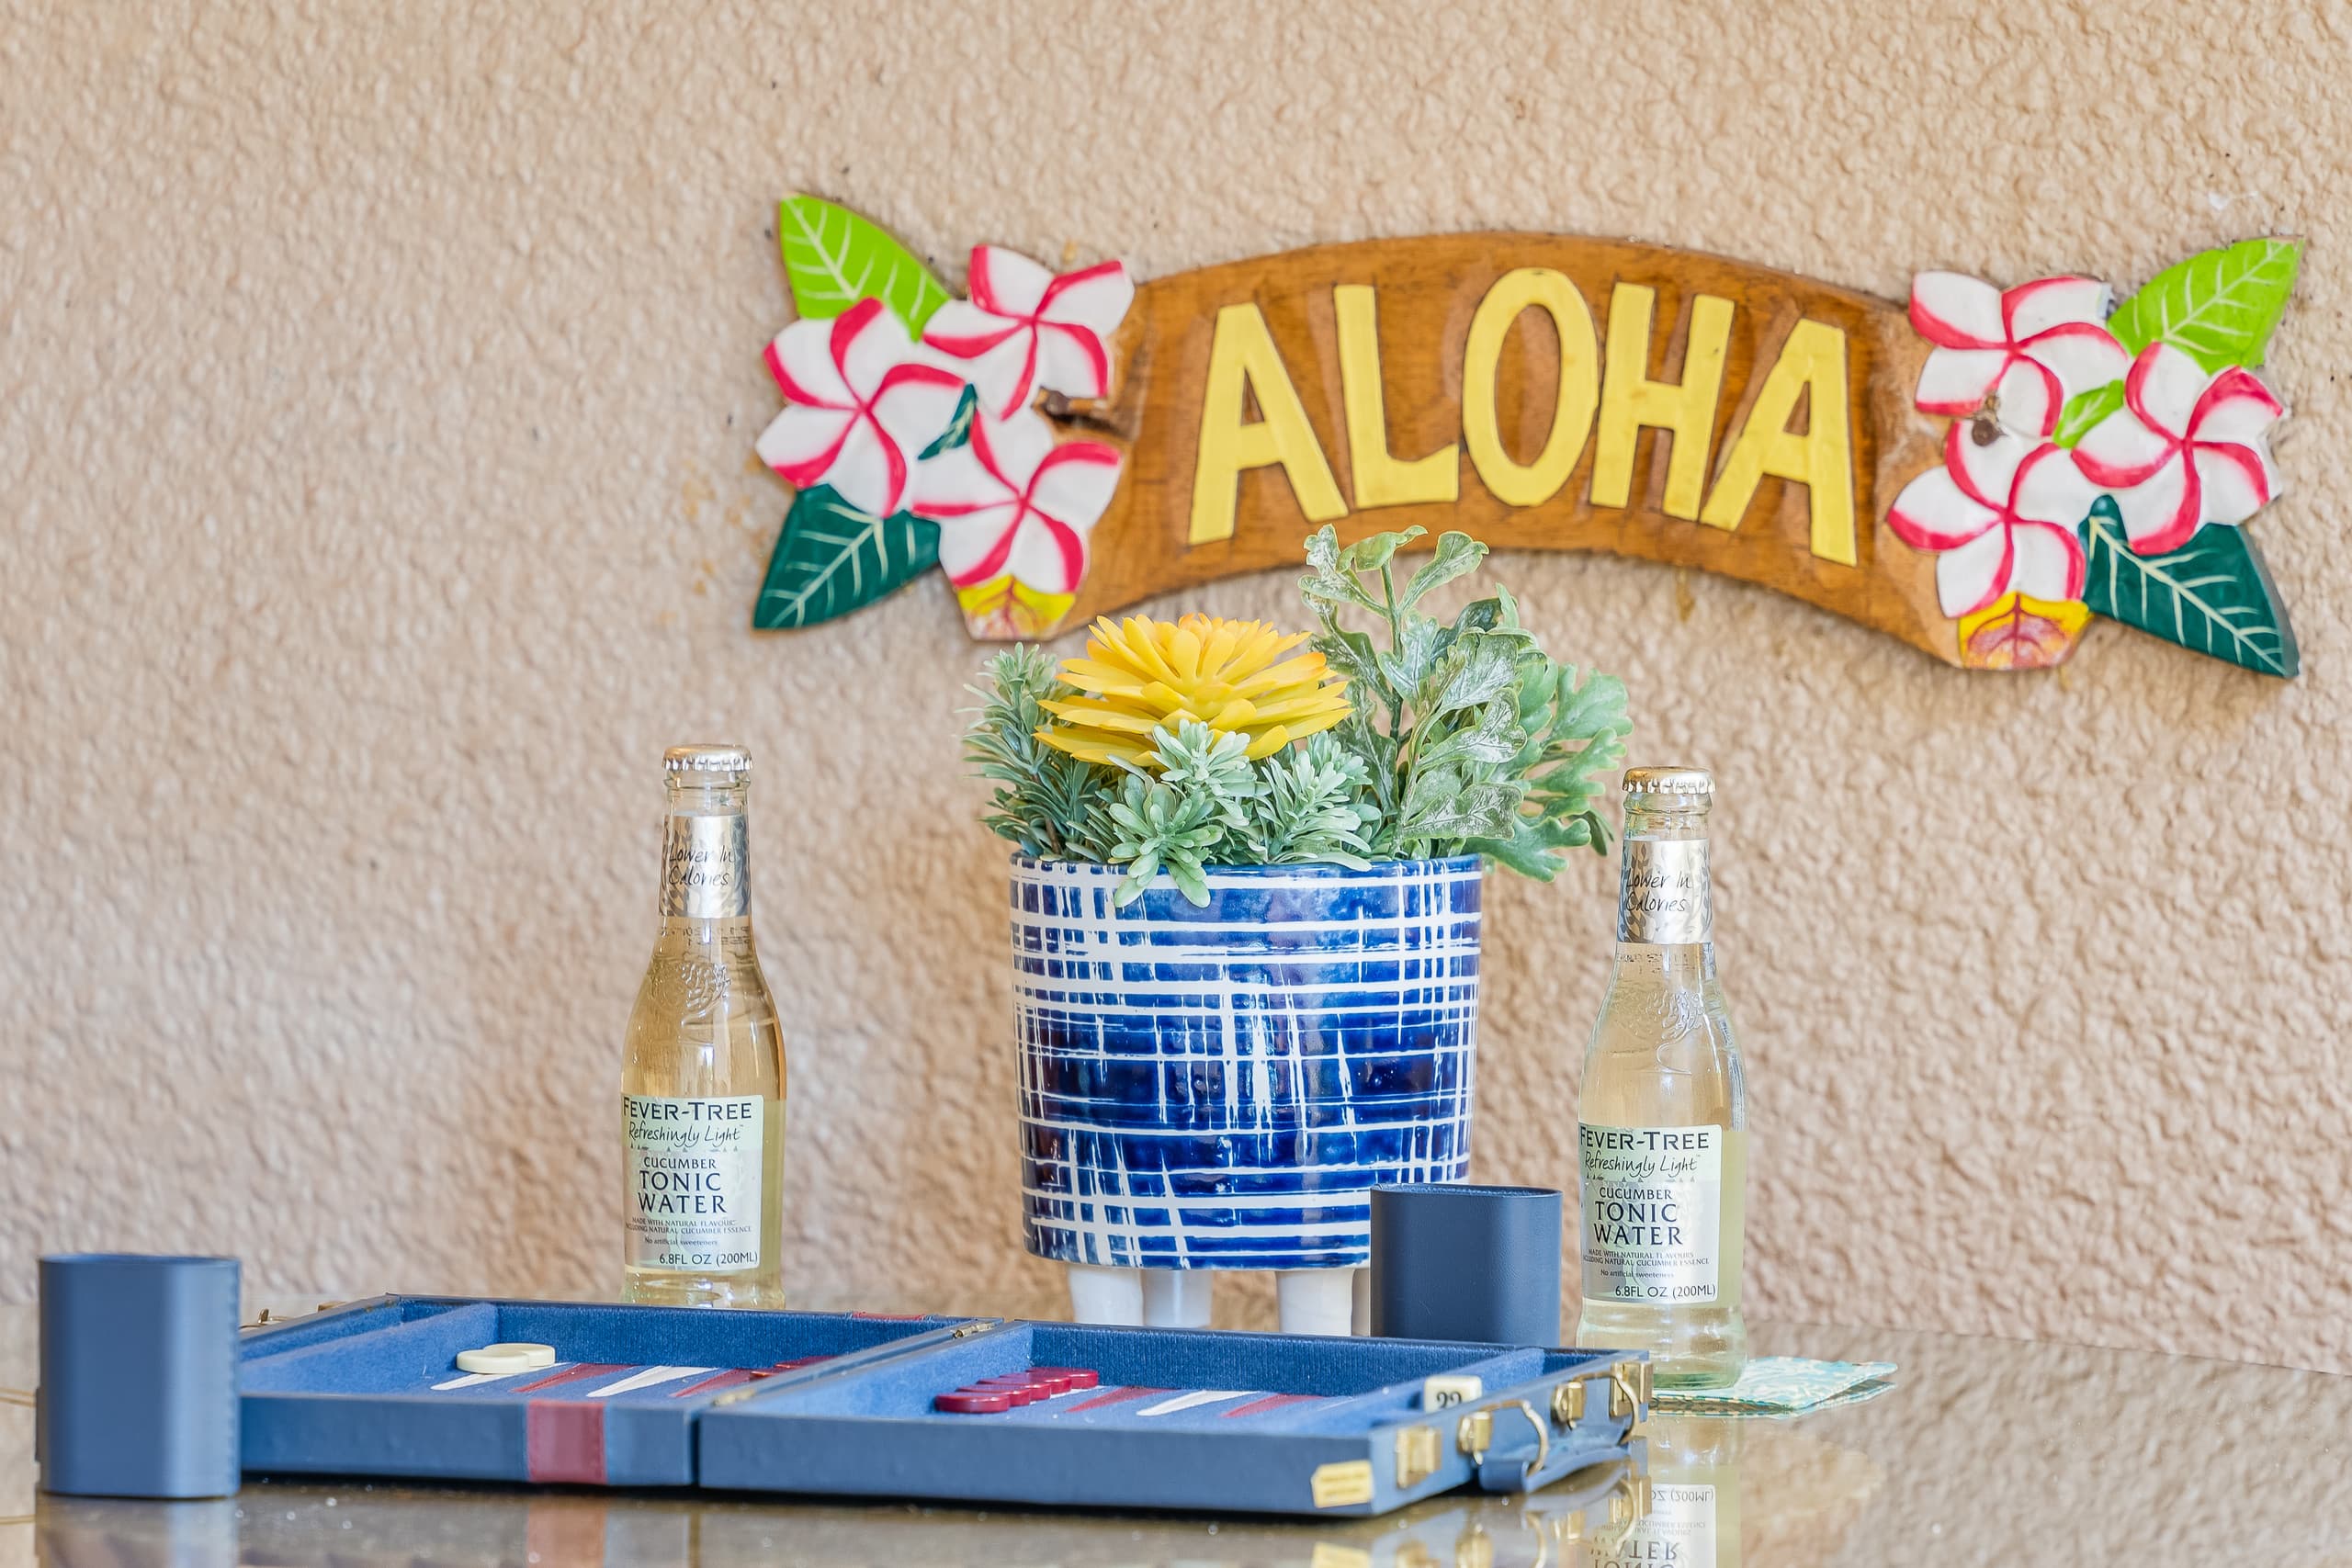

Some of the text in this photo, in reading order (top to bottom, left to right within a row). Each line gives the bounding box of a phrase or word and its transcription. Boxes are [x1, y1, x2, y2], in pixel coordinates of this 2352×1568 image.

[1189, 266, 1858, 568] ALOHA
[669, 844, 709, 863] Lower
[668, 865, 730, 886] Calories
[1625, 868, 1670, 889] Lower
[1624, 891, 1687, 912] Calories
[623, 1096, 752, 1122] FEVER-TREE
[628, 1120, 741, 1148] Refreshingly Light
[1579, 1125, 1710, 1151] FEVER-TREE
[643, 1156, 718, 1169] CUCUMBER
[1584, 1149, 1698, 1179] Refreshingly Light
[639, 1170, 722, 1191] TONIC
[638, 1192, 728, 1213] WATER
[1599, 1187, 1673, 1200] CUCUMBER
[647, 1218, 663, 1226] WITH
[664, 1219, 698, 1227] NATURAL
[1594, 1201, 1678, 1223] TONIC
[648, 1225, 679, 1235] NATURAL
[680, 1226, 721, 1235] CUCUMBER
[1593, 1223, 1683, 1246] WATER
[659, 1251, 758, 1267] 6.8FL OZ (200ML)
[1588, 1248, 1602, 1257] MADE
[1603, 1250, 1619, 1258] WITH
[1620, 1251, 1654, 1259] NATURAL
[1604, 1258, 1634, 1266] NATURAL
[1636, 1258, 1678, 1267] CUCUMBER
[1600, 1268, 1609, 1277] No
[1610, 1269, 1634, 1278] artificial
[1615, 1283, 1716, 1300] 6.8FL OZ (200ML)
